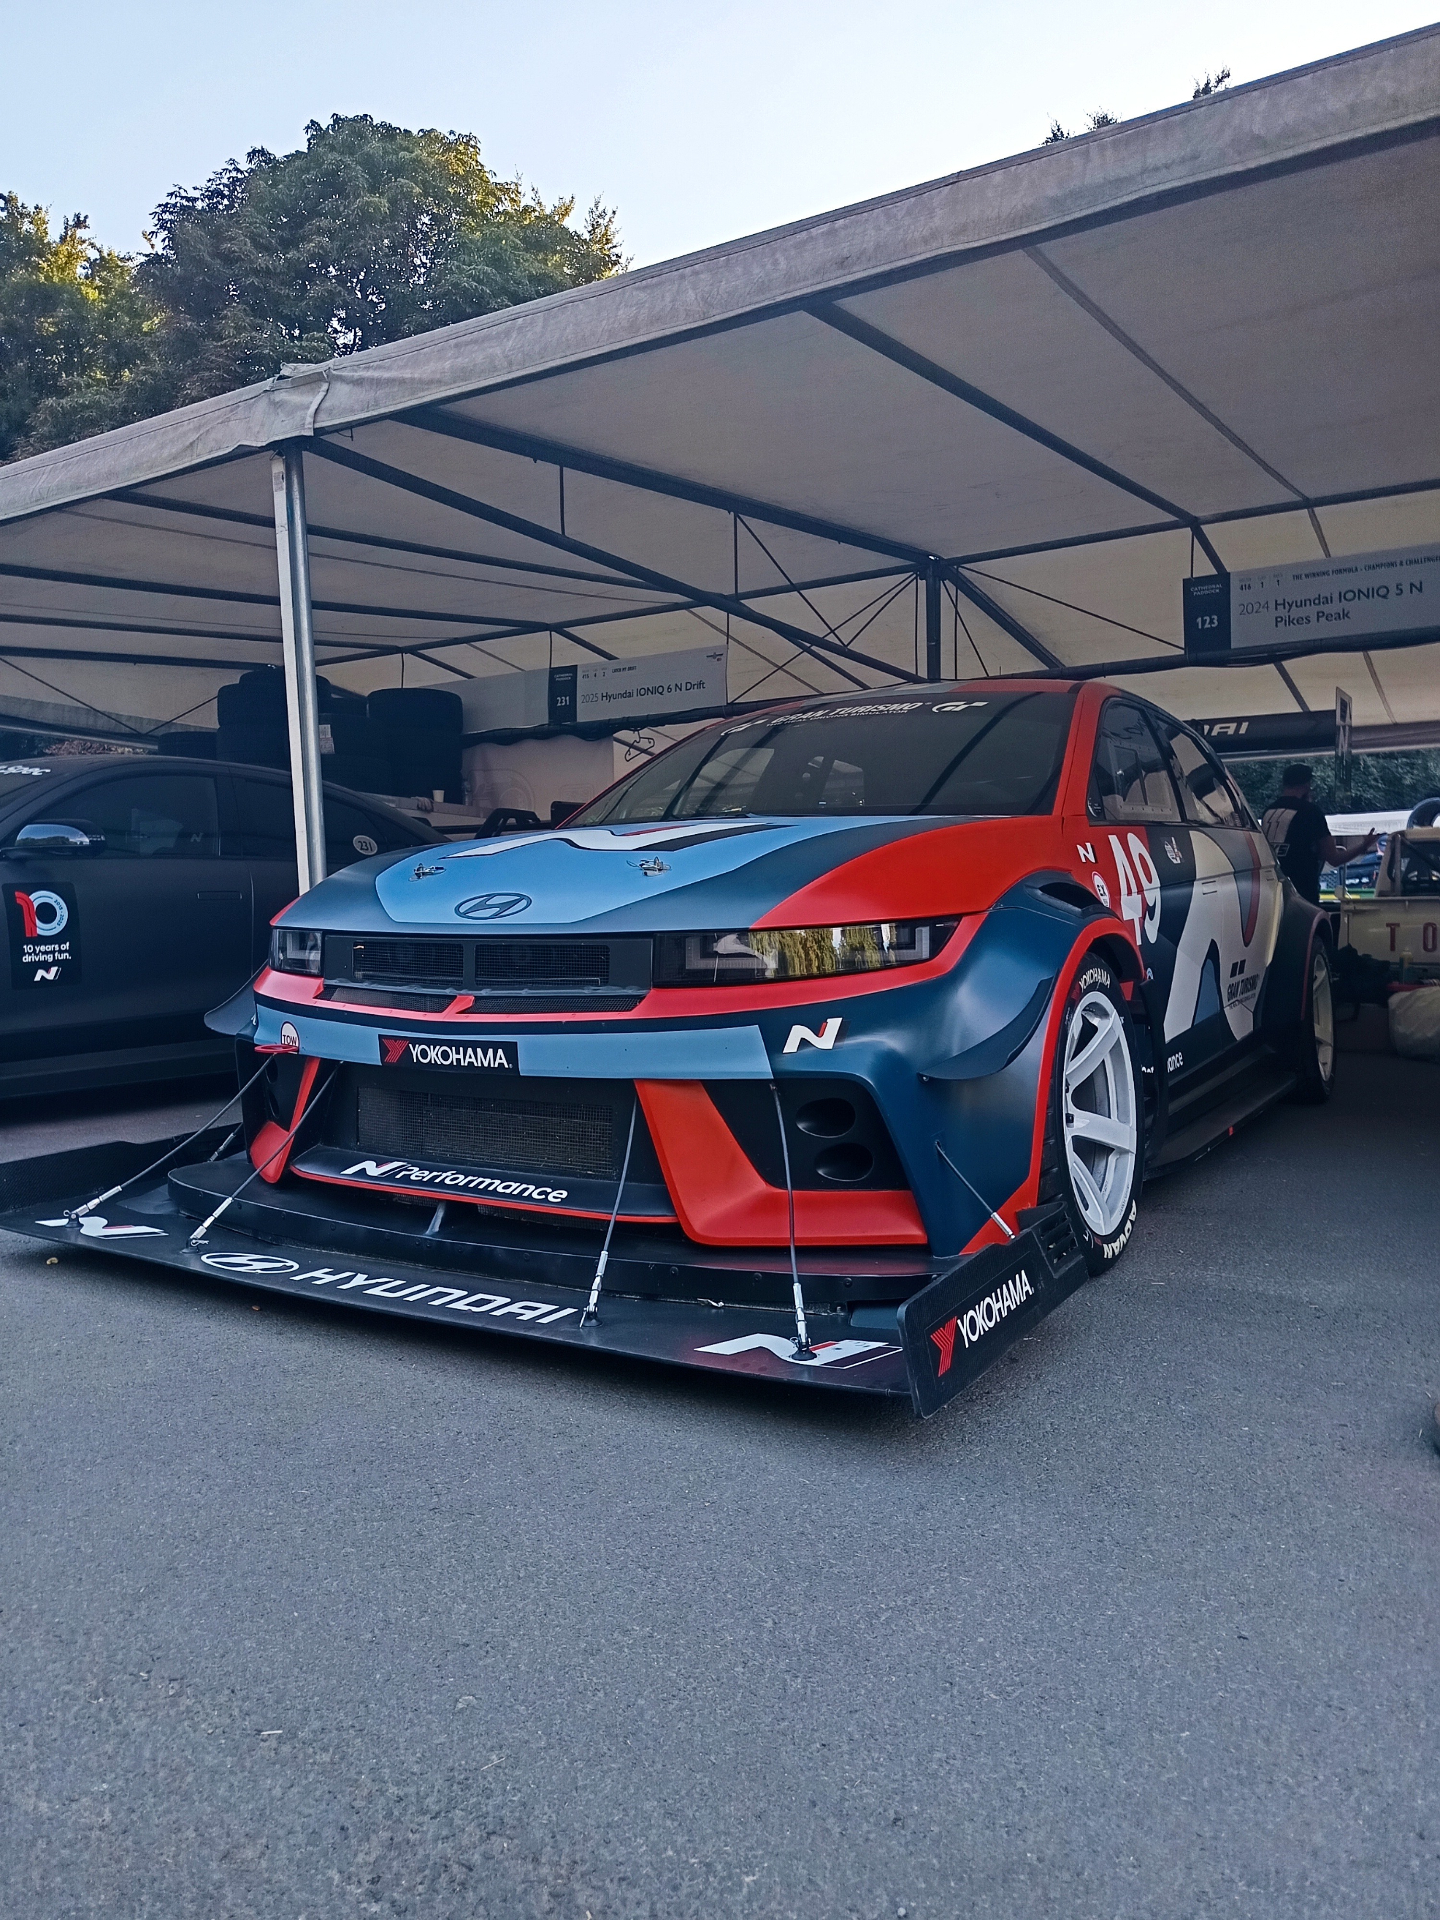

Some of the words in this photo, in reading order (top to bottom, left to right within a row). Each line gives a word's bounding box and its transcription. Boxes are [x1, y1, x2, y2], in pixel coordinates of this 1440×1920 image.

[1292, 573, 1303, 581] THE
[1304, 570, 1330, 579] WINNING
[1331, 566, 1358, 575] FORMULA
[1364, 561, 1398, 571] CHAMPIONS
[1190, 583, 1223, 592] CATHEDRAL
[1239, 601, 1270, 616] 2024
[1274, 593, 1334, 613] Hyundai
[1338, 584, 1390, 604] IONIQ
[1395, 582, 1404, 596] 5
[1409, 581, 1423, 594] N
[1196, 614, 1219, 629] 123
[1274, 610, 1311, 628] Pikes
[1316, 607, 1351, 623] Peak
[556, 696, 570, 707] 231
[581, 693, 599, 704] 2025
[600, 688, 634, 704] Hyundai
[636, 684, 664, 698] IONIQ
[666, 684, 673, 693] 6
[674, 683, 683, 692] N
[685, 680, 706, 691] Drift
[829, 702, 924, 716] TURISMO
[357, 840, 373, 852] 231
[1076, 842, 1096, 863] N
[1108, 832, 1161, 946] 49
[22, 953, 53, 962] driving
[54, 952, 72, 960] fun.
[23, 944, 34, 953] 10
[35, 944, 59, 953] years
[60, 941, 70, 951] of
[1079, 967, 1111, 993] YOKOHAMA
[282, 1034, 298, 1046] TOW
[783, 1017, 843, 1054] N
[408, 1043, 509, 1069] YOKOHAMA
[396, 1164, 569, 1203] Performance
[290, 1266, 581, 1325] HYUNDAI
[956, 1269, 1034, 1348] YOKOHAMA
